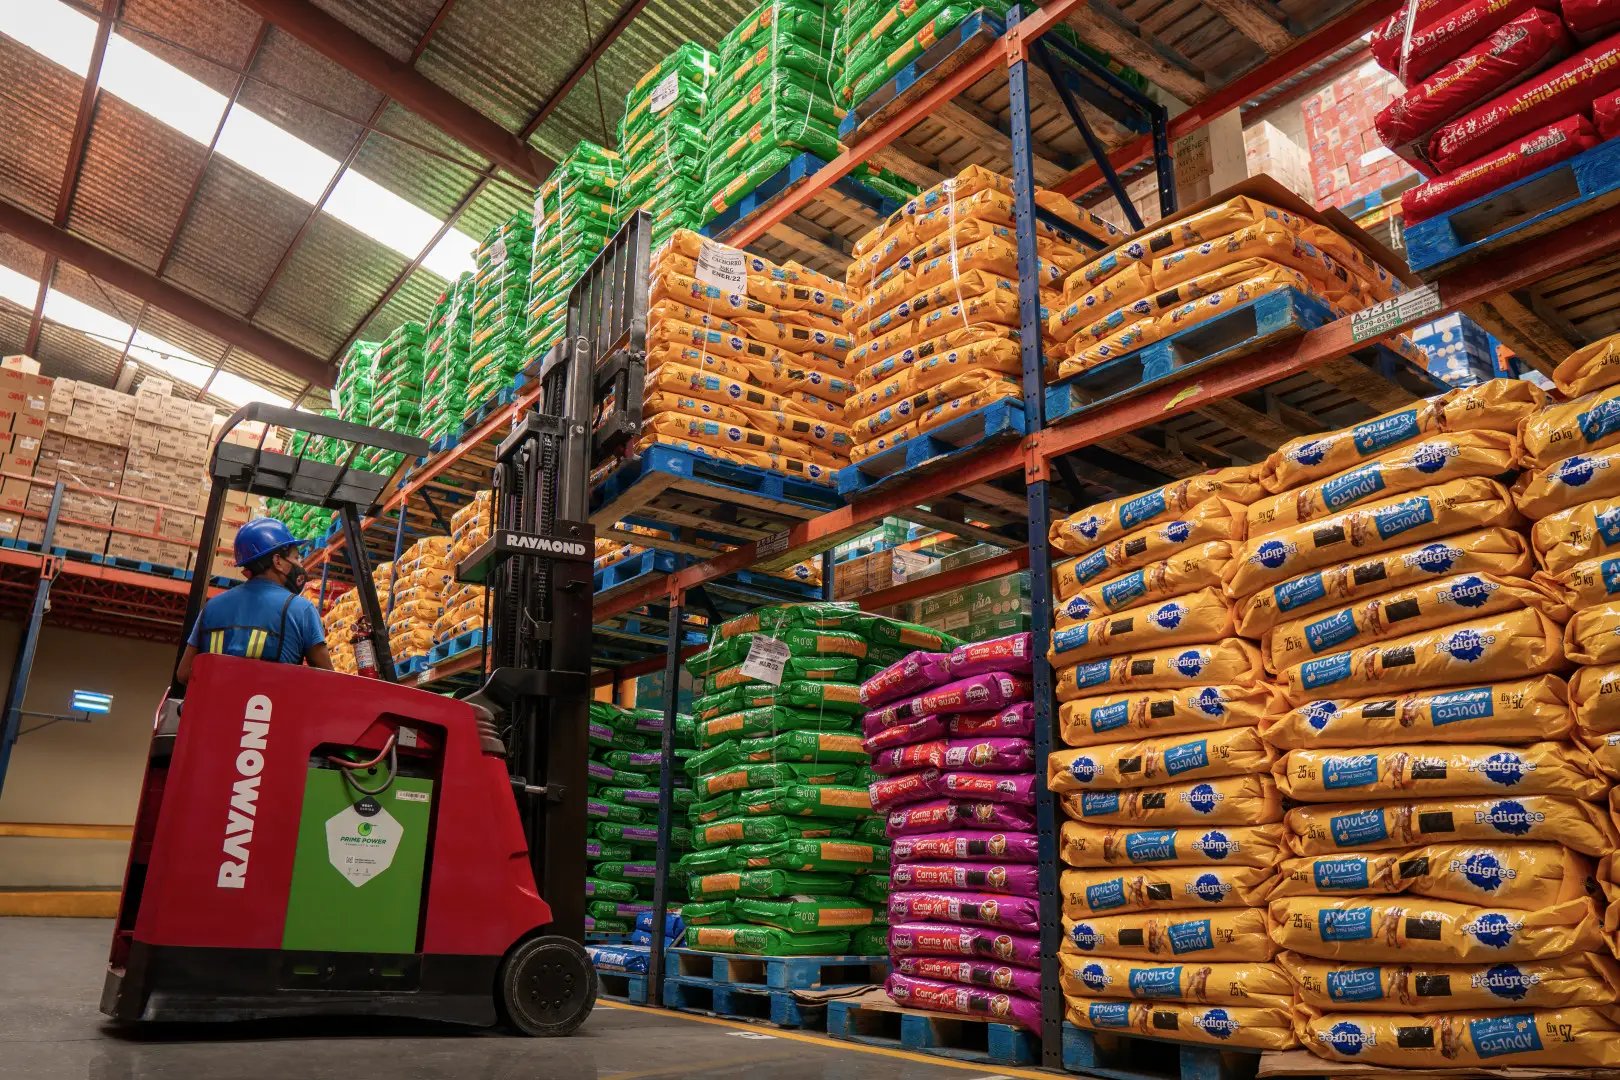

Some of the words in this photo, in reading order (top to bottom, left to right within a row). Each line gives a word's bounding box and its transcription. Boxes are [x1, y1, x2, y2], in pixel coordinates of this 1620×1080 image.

[712, 270, 741, 282] ENER/22
[1354, 298, 1398, 324] A-7-1-P
[1354, 311, 1396, 332] 3879-6194
[37, 377, 52, 387] 3M
[8, 392, 24, 401] 3M
[1466, 399, 1476, 410] 25
[1477, 400, 1485, 409] kg
[28, 417, 43, 427] 3M
[1562, 431, 1573, 441] kg
[16, 458, 32, 467] 3M
[1547, 457, 1611, 482] Pedigree
[1331, 477, 1376, 505] ADULTO
[8, 498, 23, 507] 3M
[1124, 488, 1165, 513] ADULTO
[1384, 510, 1425, 533] ADULTO
[1160, 520, 1195, 539] Pedigree
[507, 534, 586, 555] RAYMOND
[1570, 531, 1582, 544] 25
[1582, 533, 1591, 543] kg
[1249, 542, 1297, 565] Pedigree
[1404, 547, 1463, 567] Pedigree
[1183, 558, 1192, 572] 25
[1192, 560, 1199, 570] kg
[1571, 571, 1582, 586] 25
[1582, 575, 1594, 585] kg
[1107, 576, 1139, 596] ADULTO
[1277, 575, 1319, 597] ADULTO
[1437, 581, 1500, 603] Pedigree
[949, 595, 964, 607] LALA
[973, 596, 992, 611] LALA
[926, 603, 939, 615] LALA
[1147, 606, 1189, 623] Pedigree
[1311, 613, 1348, 637] ADULTO
[971, 628, 986, 640] LALA
[1284, 638, 1294, 651] 25
[1294, 638, 1302, 650] kg
[1435, 635, 1495, 653] Pedigree
[970, 647, 989, 656] Carne
[759, 660, 779, 670] MAR/22
[1168, 656, 1209, 668] Pedigree
[1306, 654, 1346, 673] ADULTO
[941, 695, 960, 705] Carne
[1501, 693, 1512, 704] kg
[1438, 703, 1485, 718] ADULTO
[1074, 715, 1080, 727] 25
[1080, 715, 1087, 727] kg
[1220, 746, 1229, 758] 25
[1170, 753, 1203, 770] ADULTO
[1328, 756, 1370, 772] ADULTO
[1468, 760, 1537, 773] Pedigree
[1298, 765, 1307, 779] 25
[1308, 768, 1316, 781] kg
[217, 694, 273, 889] RAYMOND
[898, 780, 917, 790] Carne
[975, 780, 992, 789] Carne
[1180, 792, 1224, 803] Pedigree
[912, 809, 930, 819] Carne
[1475, 811, 1545, 824] Pedigree
[1336, 813, 1378, 830] ADULTO
[1308, 827, 1317, 839] 25
[1317, 827, 1325, 840] kg
[916, 842, 938, 851] Carne
[1078, 839, 1085, 851] 25
[1192, 841, 1240, 852] Pedigree
[1132, 845, 1170, 860] ADULTO
[916, 870, 937, 879] Carne
[1319, 862, 1361, 876] ADULTO
[1450, 860, 1516, 879] Pedigree
[1090, 883, 1119, 898] ADULTO
[1186, 883, 1231, 894] Pedigree
[1070, 893, 1077, 904] 25
[1077, 894, 1084, 905] kg
[913, 902, 932, 911] Carne
[1293, 913, 1303, 928] 25
[1303, 918, 1312, 930] kg
[1325, 910, 1366, 922] ADULTO
[1216, 929, 1224, 937] kg
[1462, 921, 1523, 935] Pedigree
[918, 935, 940, 945] Carne
[1175, 935, 1207, 950] ADULTO
[1224, 930, 1235, 942] 25
[920, 961, 940, 972] Carne
[1073, 970, 1112, 984] Pedigree
[1133, 969, 1175, 983] ADULTO
[1332, 971, 1374, 986] ADULTO
[1471, 974, 1540, 988] Pedigree
[1229, 982, 1239, 996] 25
[1302, 976, 1312, 991] 25
[1312, 981, 1321, 994] kg
[915, 987, 938, 999] Carne
[1093, 1004, 1125, 1015] ADULTO
[1193, 1016, 1239, 1030] Pedigree
[1546, 1022, 1559, 1036] kg
[1318, 1031, 1377, 1048] Pedigree
[1559, 1023, 1575, 1043] 25
[1481, 1035, 1532, 1051] ADULTO
